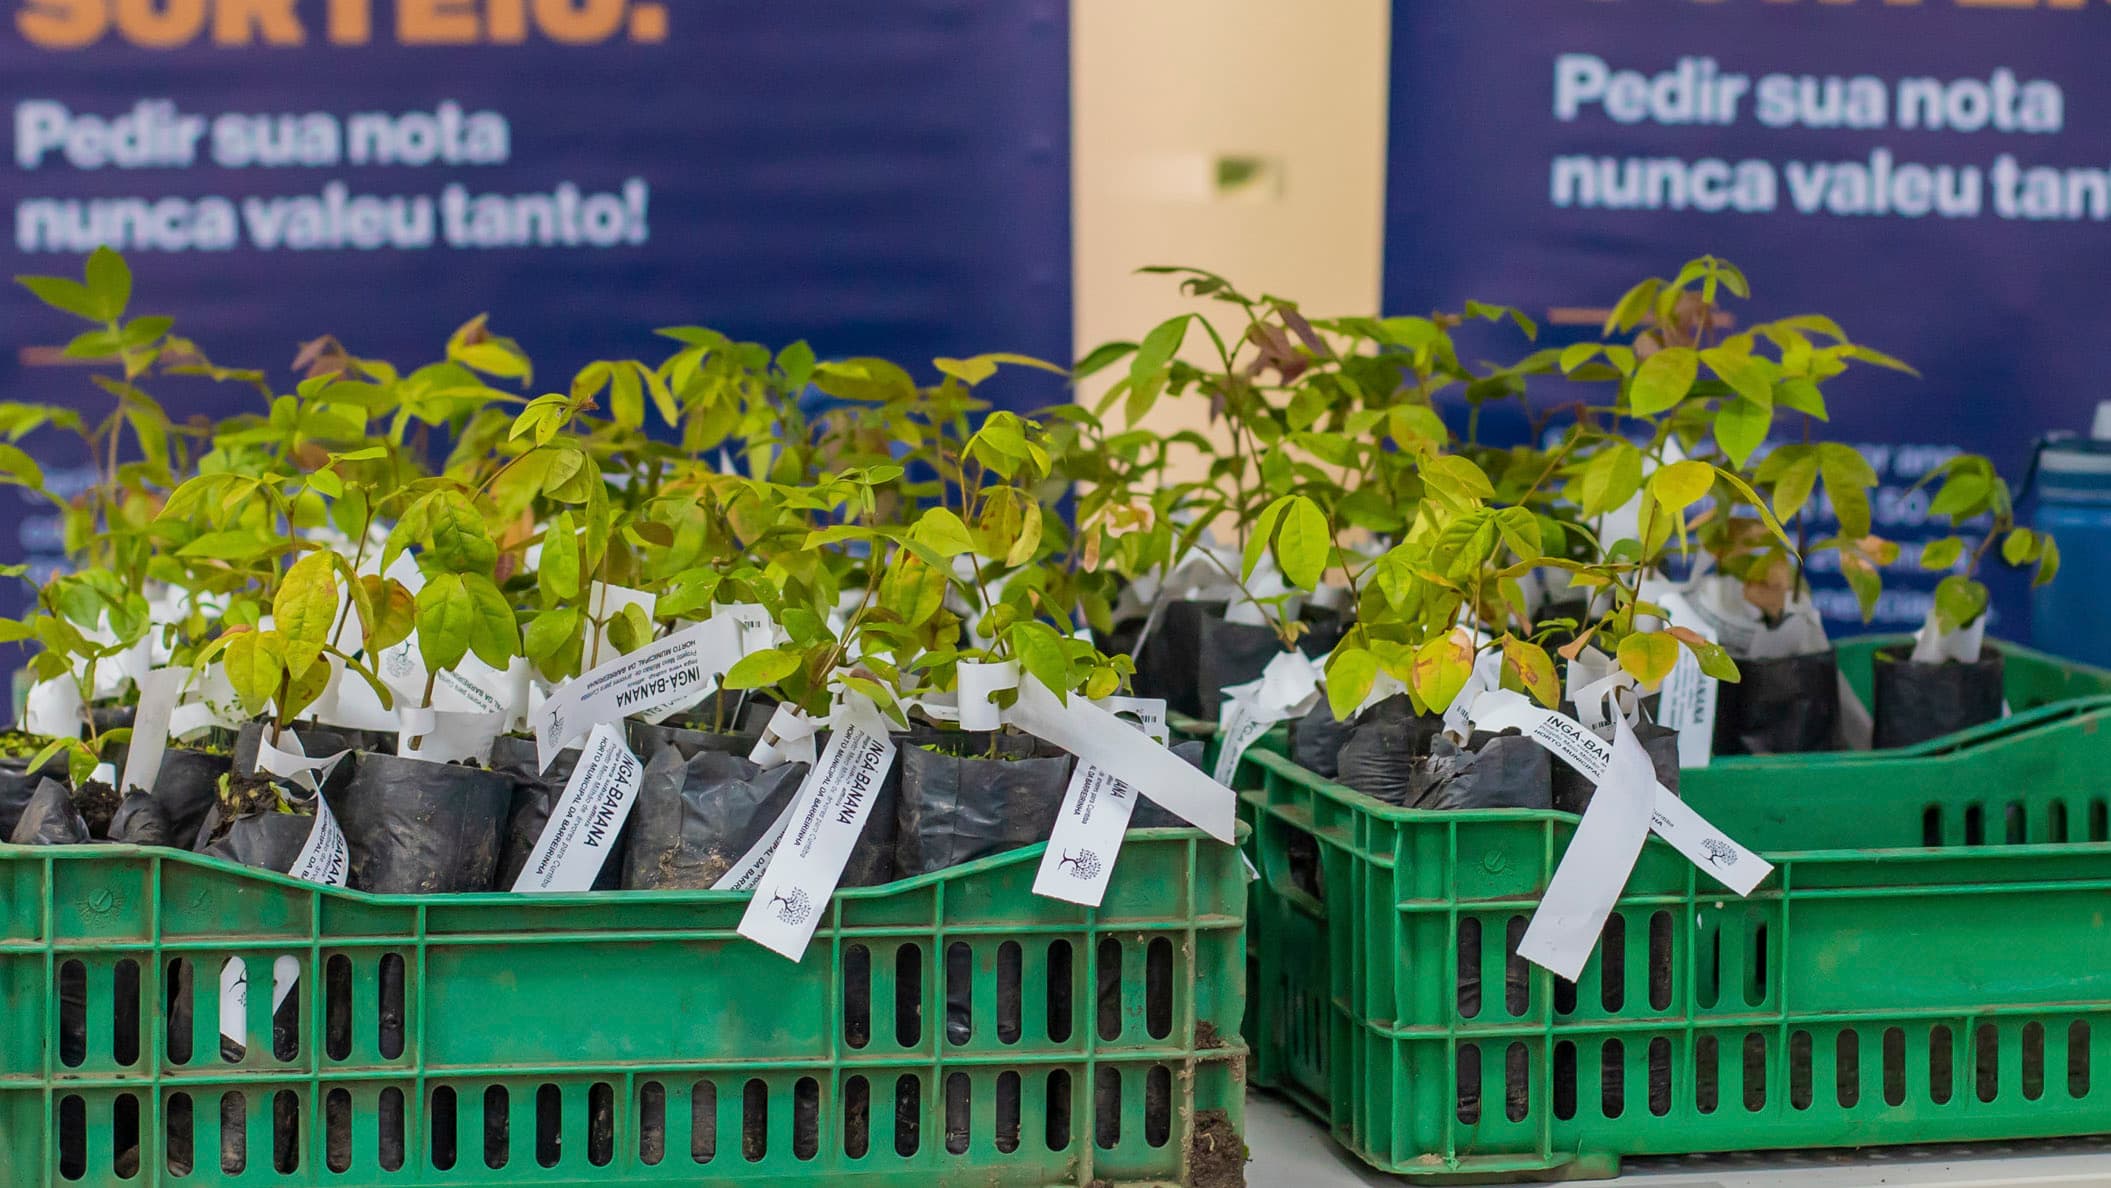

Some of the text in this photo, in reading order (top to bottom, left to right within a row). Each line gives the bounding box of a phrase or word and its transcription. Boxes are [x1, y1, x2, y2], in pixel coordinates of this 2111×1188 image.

[1553, 53, 2066, 132] Pedir sua nota
[14, 100, 510, 168] Pedir sua nota
[1551, 147, 2111, 220] nunca valeu tan
[15, 176, 650, 252] nunca valeu tanto!
[672, 640, 696, 652] HORTO
[616, 666, 700, 708] INGÁ-BANANA
[1534, 729, 1600, 777] HORTO MUNICIPAL
[1547, 716, 1608, 762] INGÁ-BAN
[536, 736, 608, 874] HORTO MUNICIPAL DA BARREIRINHA
[583, 755, 634, 847] INGÁ-BANANA
[794, 724, 855, 846] HORTO MUNICIPAL DA BARREIRINHA
[836, 739, 885, 824] INGÁ-BANANA
[1074, 777, 1092, 815] BARREIRINHA
[306, 856, 316, 868] DA
[541, 860, 560, 888] Curitiba
[556, 842, 568, 859] para
[753, 857, 765, 868] DA
